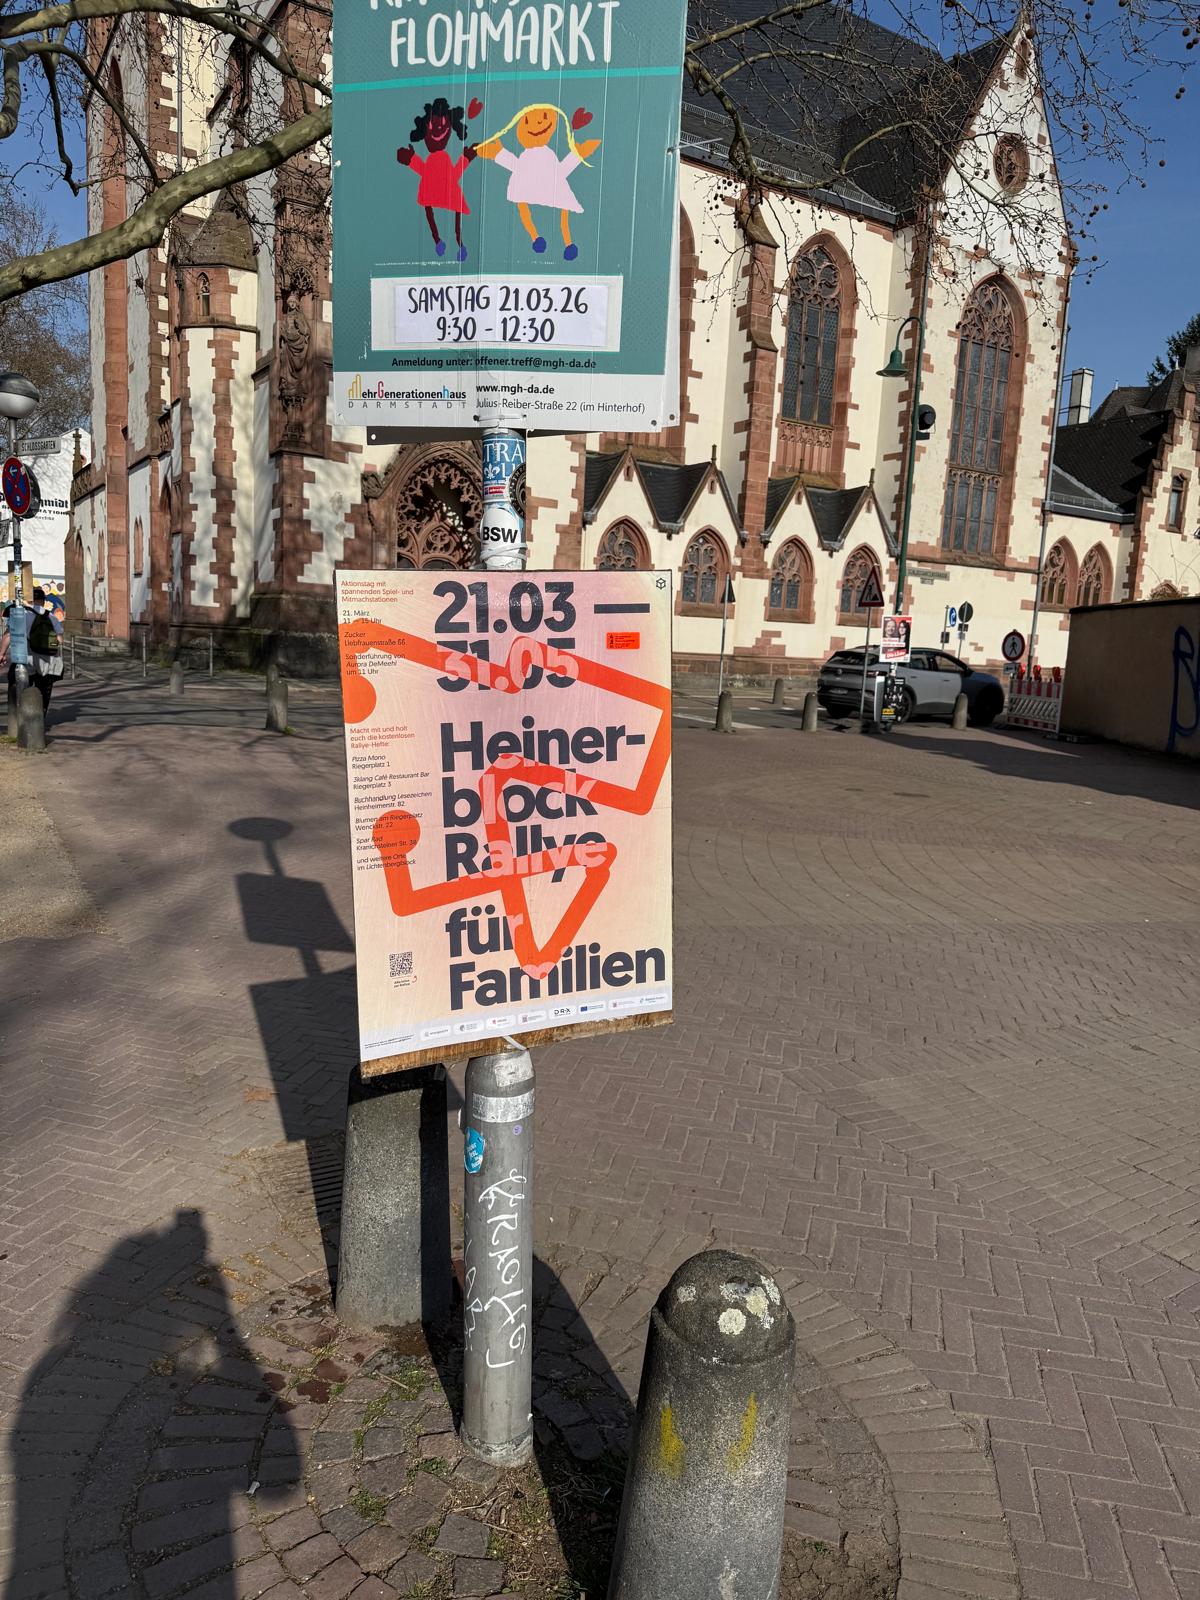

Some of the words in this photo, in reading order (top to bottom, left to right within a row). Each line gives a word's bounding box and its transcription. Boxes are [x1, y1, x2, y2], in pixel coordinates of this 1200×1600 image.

[391, 2, 620, 71] FLOHMARKT
[407, 285, 491, 316] SAMSTAG
[499, 286, 588, 315] 21.03.26
[436, 316, 476, 342] 9:30
[501, 315, 555, 343] 12:30
[391, 357, 443, 369] Anmeldung
[446, 358, 473, 367] unter:
[475, 357, 597, 369] offener.treff@mgh-da.de
[348, 373, 467, 399] MehrGenerationenhaus
[476, 384, 555, 396] www.mgh-da.de
[348, 401, 466, 409] DARMSTADT
[476, 399, 563, 411] Julius-Reiber-Straße
[566, 401, 577, 411] 22
[579, 401, 594, 413] (im
[597, 402, 646, 415] Hinterhof)
[22, 441, 56, 451] SCHLOSSGARTEN
[482, 527, 518, 544] BSW
[341, 588, 381, 596] spannenden
[433, 580, 577, 634] 21.03
[370, 616, 382, 624] Uhr
[344, 639, 397, 647] Liebfrauenstraße
[345, 654, 392, 662] Sonderführung
[437, 636, 580, 693] 31.05
[350, 727, 370, 735] Macht
[378, 732, 415, 740] kostenlosen
[351, 741, 389, 750] Rallye-Hefte:
[440, 715, 645, 772] Heiner-
[352, 762, 385, 770] Riegerplatz
[353, 775, 373, 783] 3klang
[374, 773, 388, 781] Café
[388, 772, 419, 780] Restaurant
[353, 782, 386, 791] Riegerplatz
[354, 794, 396, 804] Buchhandlung
[397, 791, 432, 800] Lesezeichen
[442, 768, 598, 828] block
[354, 802, 396, 812] Heinheimerstr.
[355, 815, 378, 824] Blumen
[389, 811, 423, 821] Riegerplatz
[355, 823, 384, 832] Wenckstr.
[356, 837, 370, 845] Spar
[356, 842, 398, 851] Kranichsteiner
[370, 854, 392, 862] weitere
[444, 824, 608, 883] Rallye
[366, 859, 416, 870] Lichtenbergblock
[445, 904, 524, 958] für
[449, 942, 666, 1011] Familien
